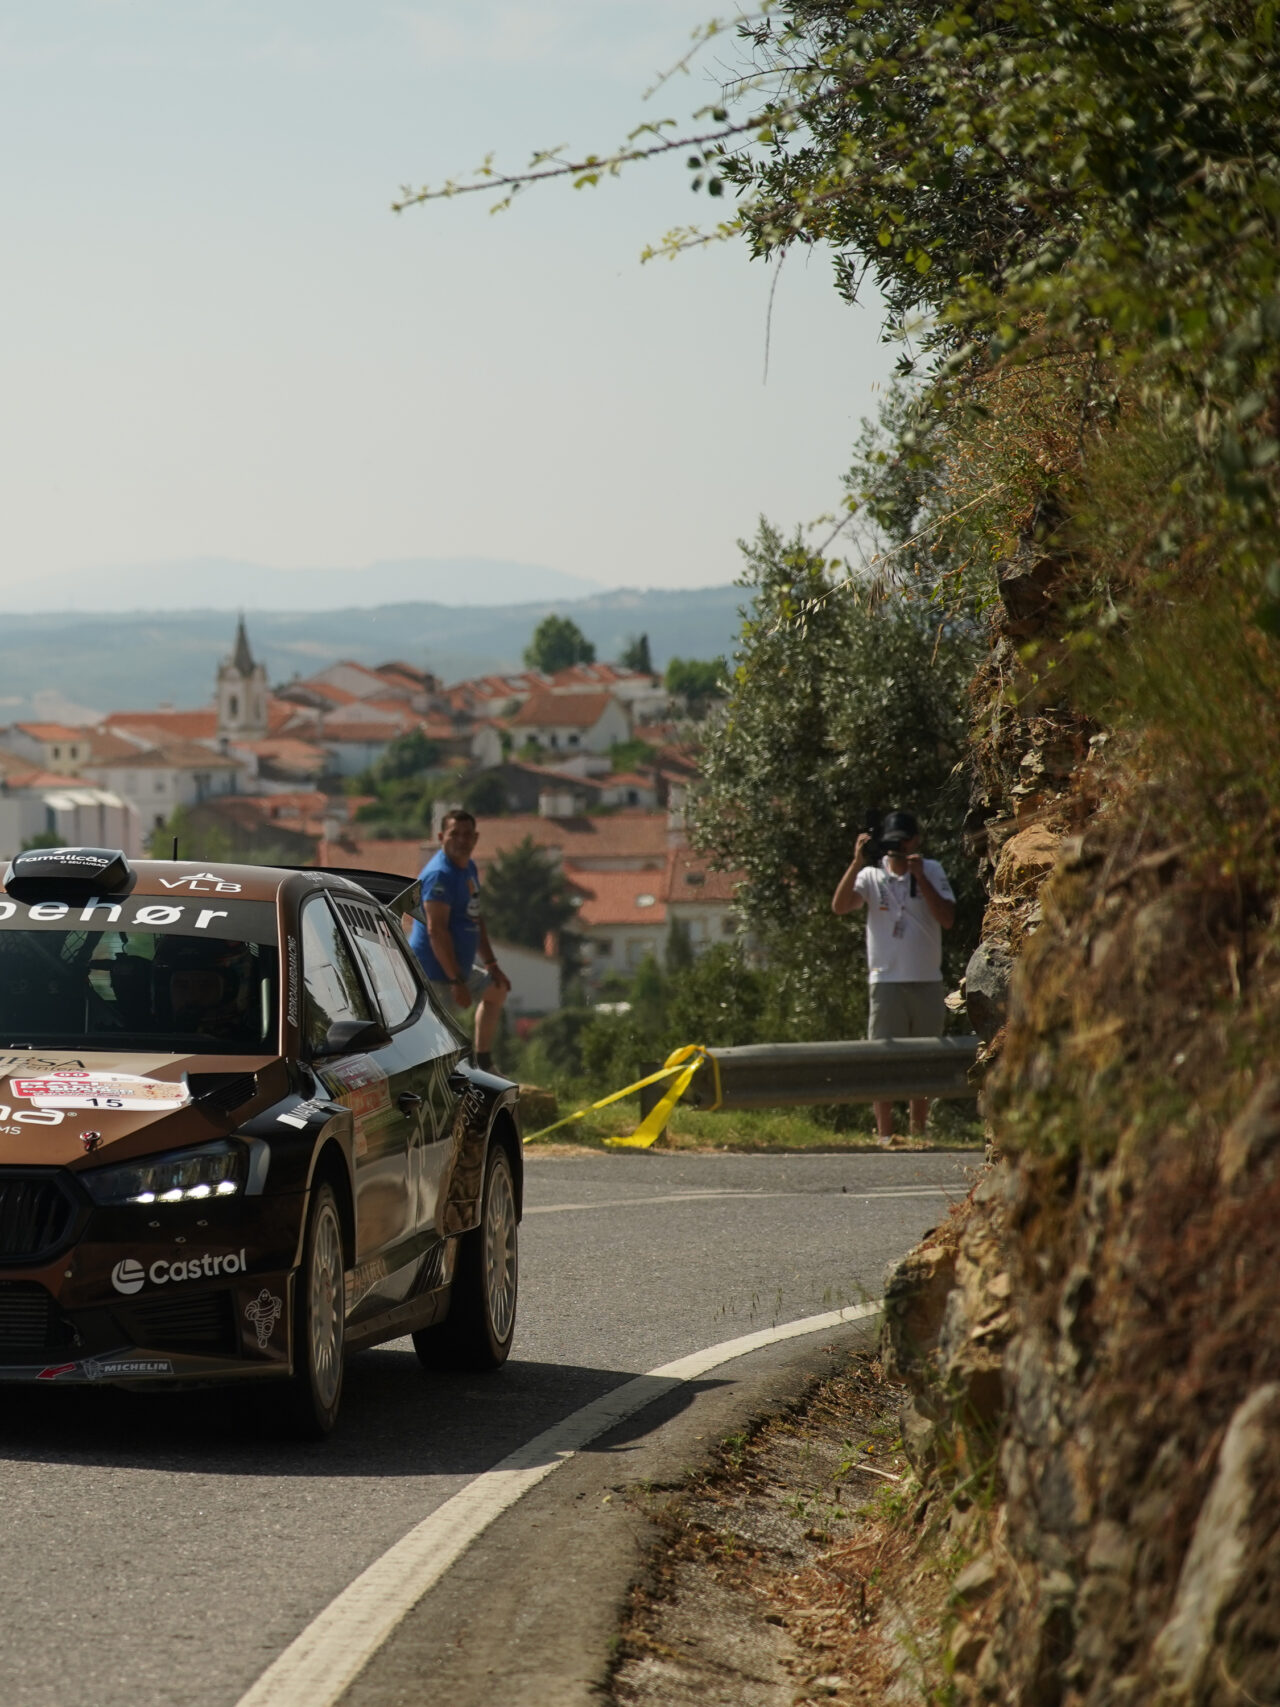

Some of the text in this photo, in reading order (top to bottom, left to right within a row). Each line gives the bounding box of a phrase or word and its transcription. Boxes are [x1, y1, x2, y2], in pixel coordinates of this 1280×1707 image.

[158, 878, 242, 893] VLB
[86, 1097, 123, 1108] 15
[149, 1248, 247, 1284] Castrol
[104, 1363, 168, 1372] MICHELIN
